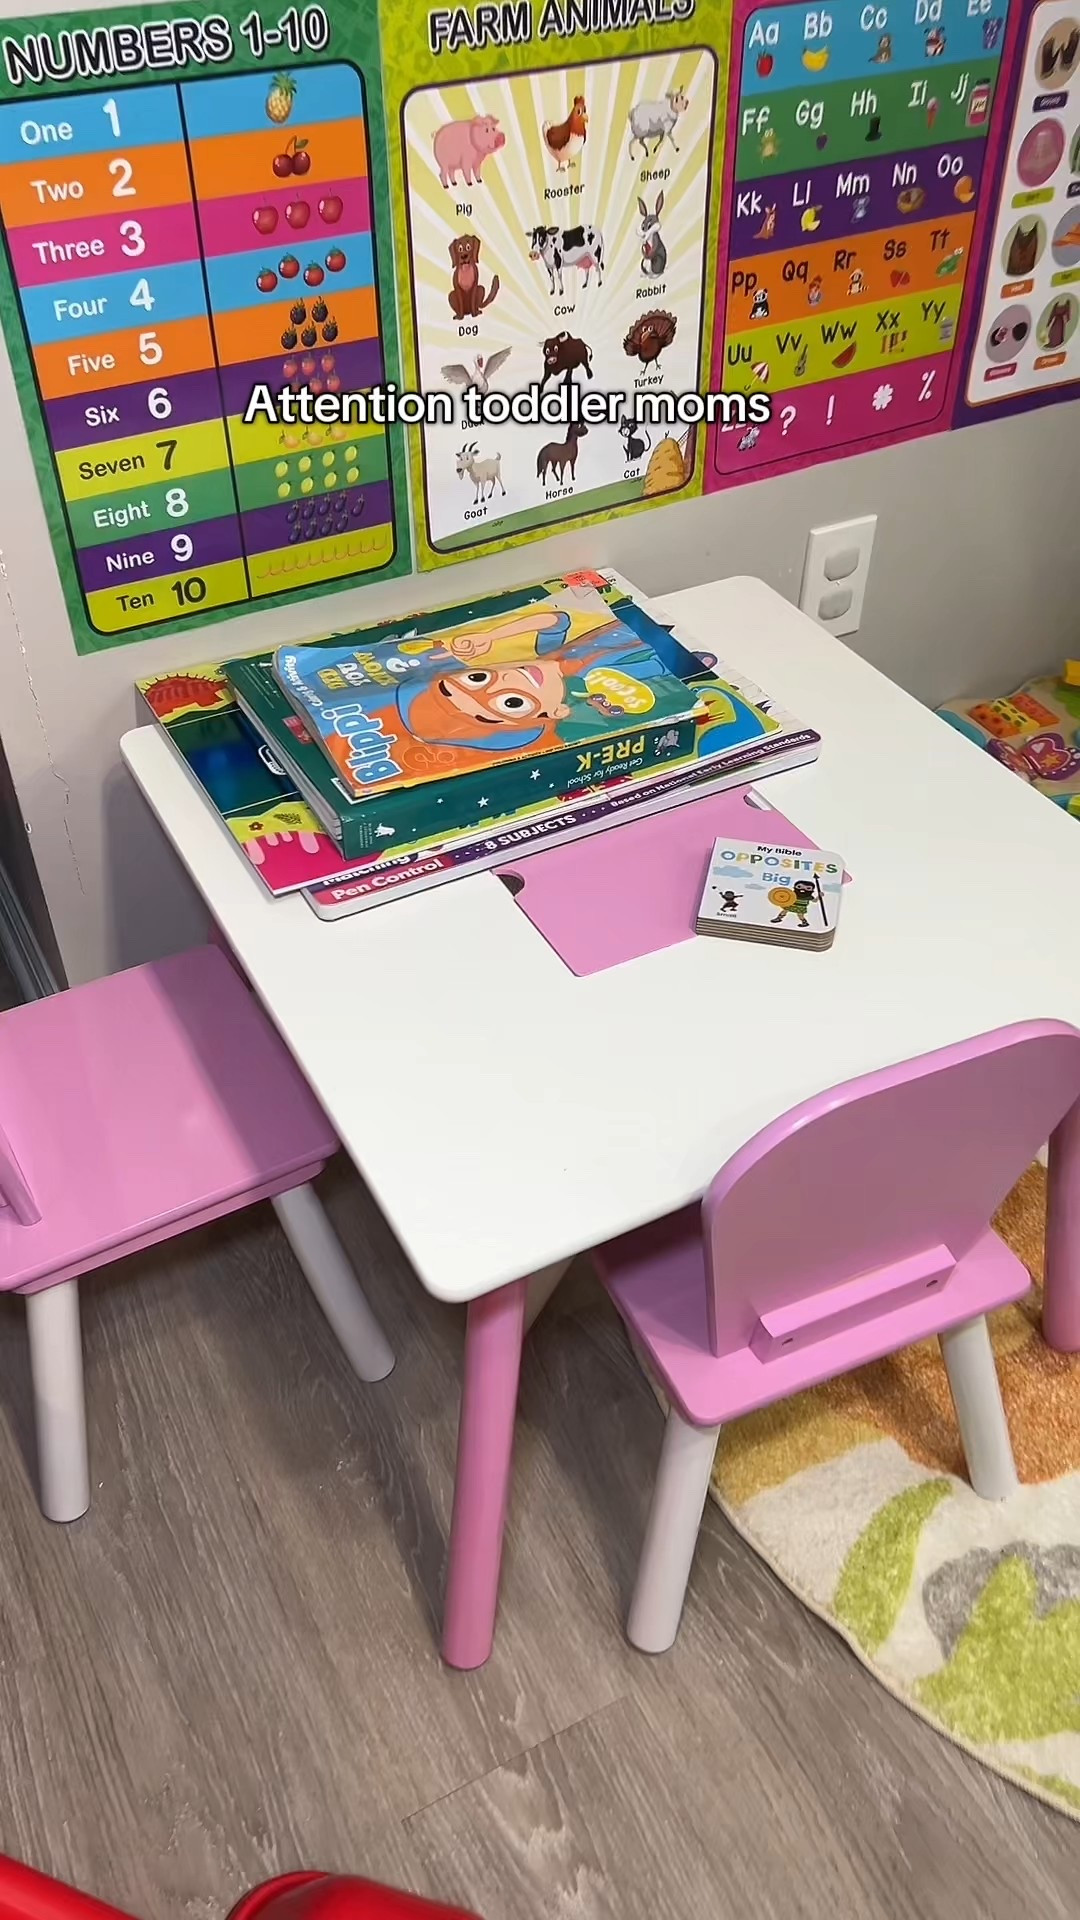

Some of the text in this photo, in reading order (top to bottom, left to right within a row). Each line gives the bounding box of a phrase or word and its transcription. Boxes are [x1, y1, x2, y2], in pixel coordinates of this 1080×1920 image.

[428, 0, 532, 52] FARM
[749, 20, 779, 48] Aa
[804, 10, 832, 40] Bb
[860, 5, 888, 31] Cc
[914, 0, 941, 24] Dd
[2, 5, 329, 85] NUMBERS 1-10
[20, 99, 121, 145] One 1
[742, 72, 969, 136] Ff Gg Hh Ii Jj
[30, 158, 136, 204] Two 2
[544, 183, 585, 200] Rooster
[640, 168, 670, 182] Sheep
[736, 154, 963, 218] Kk Ll Mm Nn Oo
[456, 203, 473, 217] Pig
[32, 220, 146, 264] Three 3
[732, 228, 950, 296] Pp Qq Rr Ss Tt
[53, 279, 155, 321] Four 4
[554, 304, 575, 317] Cow
[635, 284, 666, 299] Rabbit
[458, 325, 478, 337] Dog
[727, 301, 946, 366] Uu Vv Ww Xx Yy
[68, 332, 163, 376] Five 5
[634, 374, 664, 388] Turkey
[85, 387, 172, 427] Six 6
[780, 405, 797, 436] ?
[825, 395, 835, 426] !
[918, 370, 936, 401] %
[79, 440, 177, 480] Seven 7
[623, 467, 640, 479] Cat
[93, 488, 189, 528] Eight 8
[545, 486, 573, 499] Horse
[464, 506, 488, 520] Goat
[106, 534, 193, 573] Nine 9
[116, 577, 207, 612] Ten 10
[336, 662, 371, 686] YOU
[321, 704, 403, 784] Blippi
[576, 735, 645, 772] PRE-K
[568, 757, 642, 788] Get Ready for School
[611, 734, 811, 807] Based on National Early Learning Standards
[485, 814, 577, 850] 8 SUBJECTS
[757, 846, 802, 856] My Bible
[331, 859, 444, 901] Pen Control
[721, 851, 838, 873] OPPOSITES
[762, 872, 791, 886] Big
